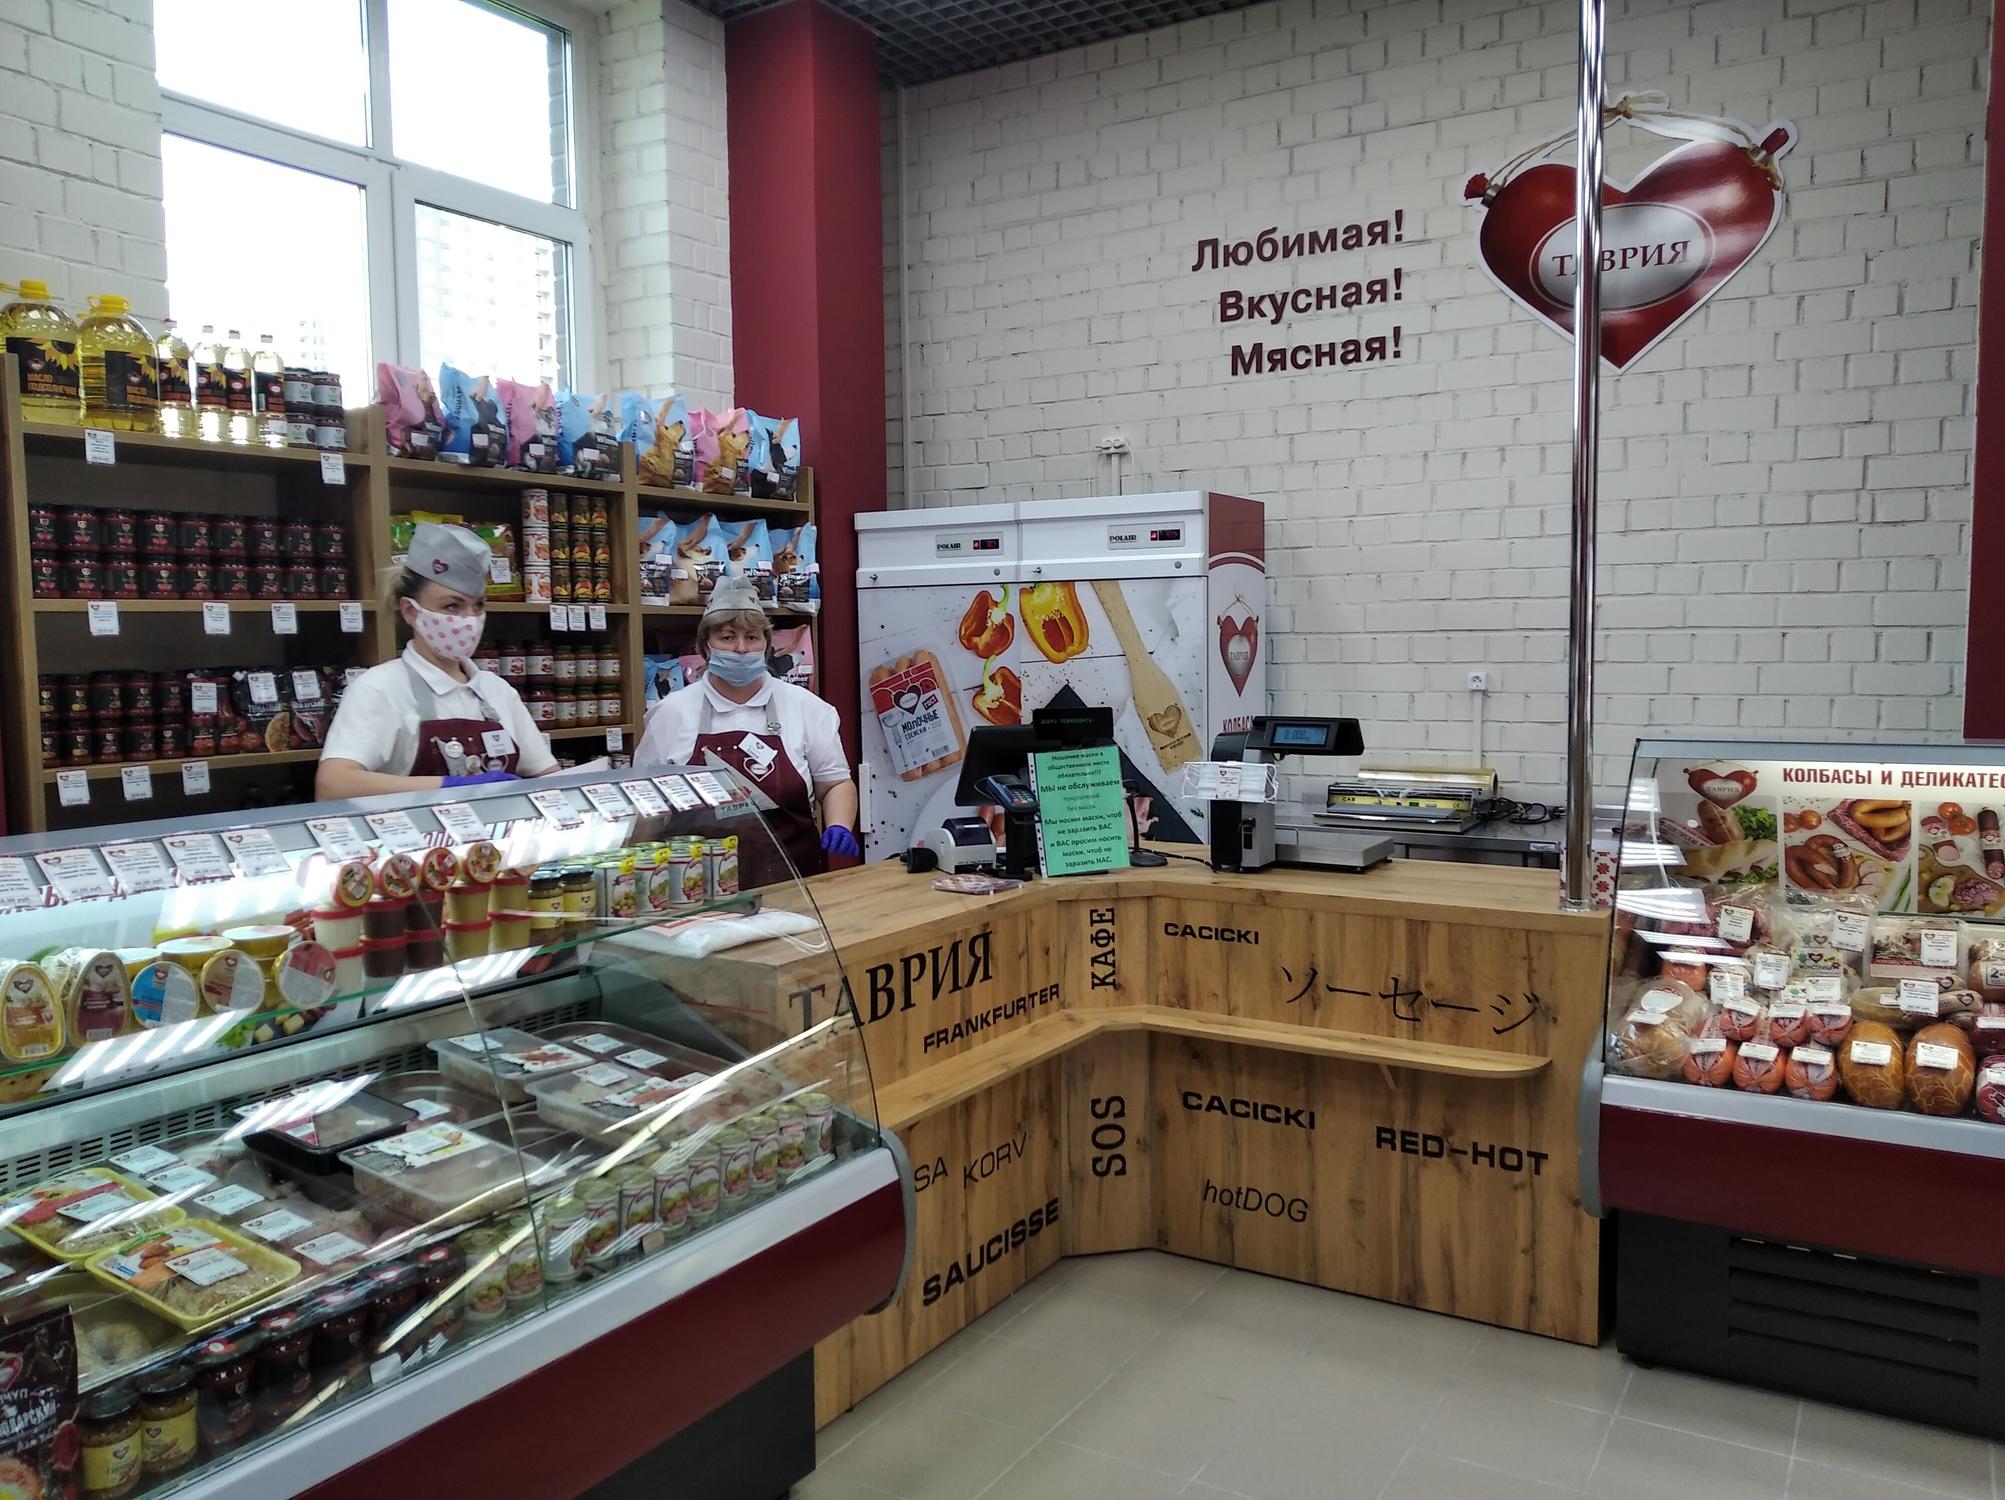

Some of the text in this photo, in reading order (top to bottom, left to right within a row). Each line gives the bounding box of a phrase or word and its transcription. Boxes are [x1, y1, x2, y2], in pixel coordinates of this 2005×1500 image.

[1191, 208, 1404, 273] Любимая!
[1552, 240, 1691, 277] ТВРИЯ
[1219, 267, 1403, 326] Вкусная!
[1230, 325, 1402, 377] Мясная!
[936, 541, 961, 551] POLAIR
[1108, 534, 1137, 544] POLAIR
[901, 709, 940, 733] МОЛОЧНЫЕ
[1068, 779, 1120, 790] обслуживаем
[1783, 767, 1873, 785] КОЛБАСЫ
[1880, 770, 1894, 785] И
[1059, 815, 1081, 824] носим
[1106, 811, 1122, 819] чтоб
[1068, 826, 1097, 834] заразить
[1098, 823, 1112, 831] ВАС
[1056, 839, 1070, 847] ВАС
[1071, 837, 1098, 847] просим
[1065, 857, 1112, 868] заразить НАС.
[1090, 907, 1116, 990] КАФЕ
[1164, 922, 1260, 945] CACICKI
[1281, 957, 1541, 1035] ソーセージ
[923, 983, 1060, 1054] FRANKFURTER
[1182, 1091, 1316, 1130] CACICKI
[1091, 1095, 1128, 1178] SOS
[1376, 1126, 1549, 1176] RED-HOT
[963, 1131, 1028, 1189] KORV
[1202, 1179, 1310, 1223] hotDOG
[922, 1197, 1060, 1307] SAUCISSE
